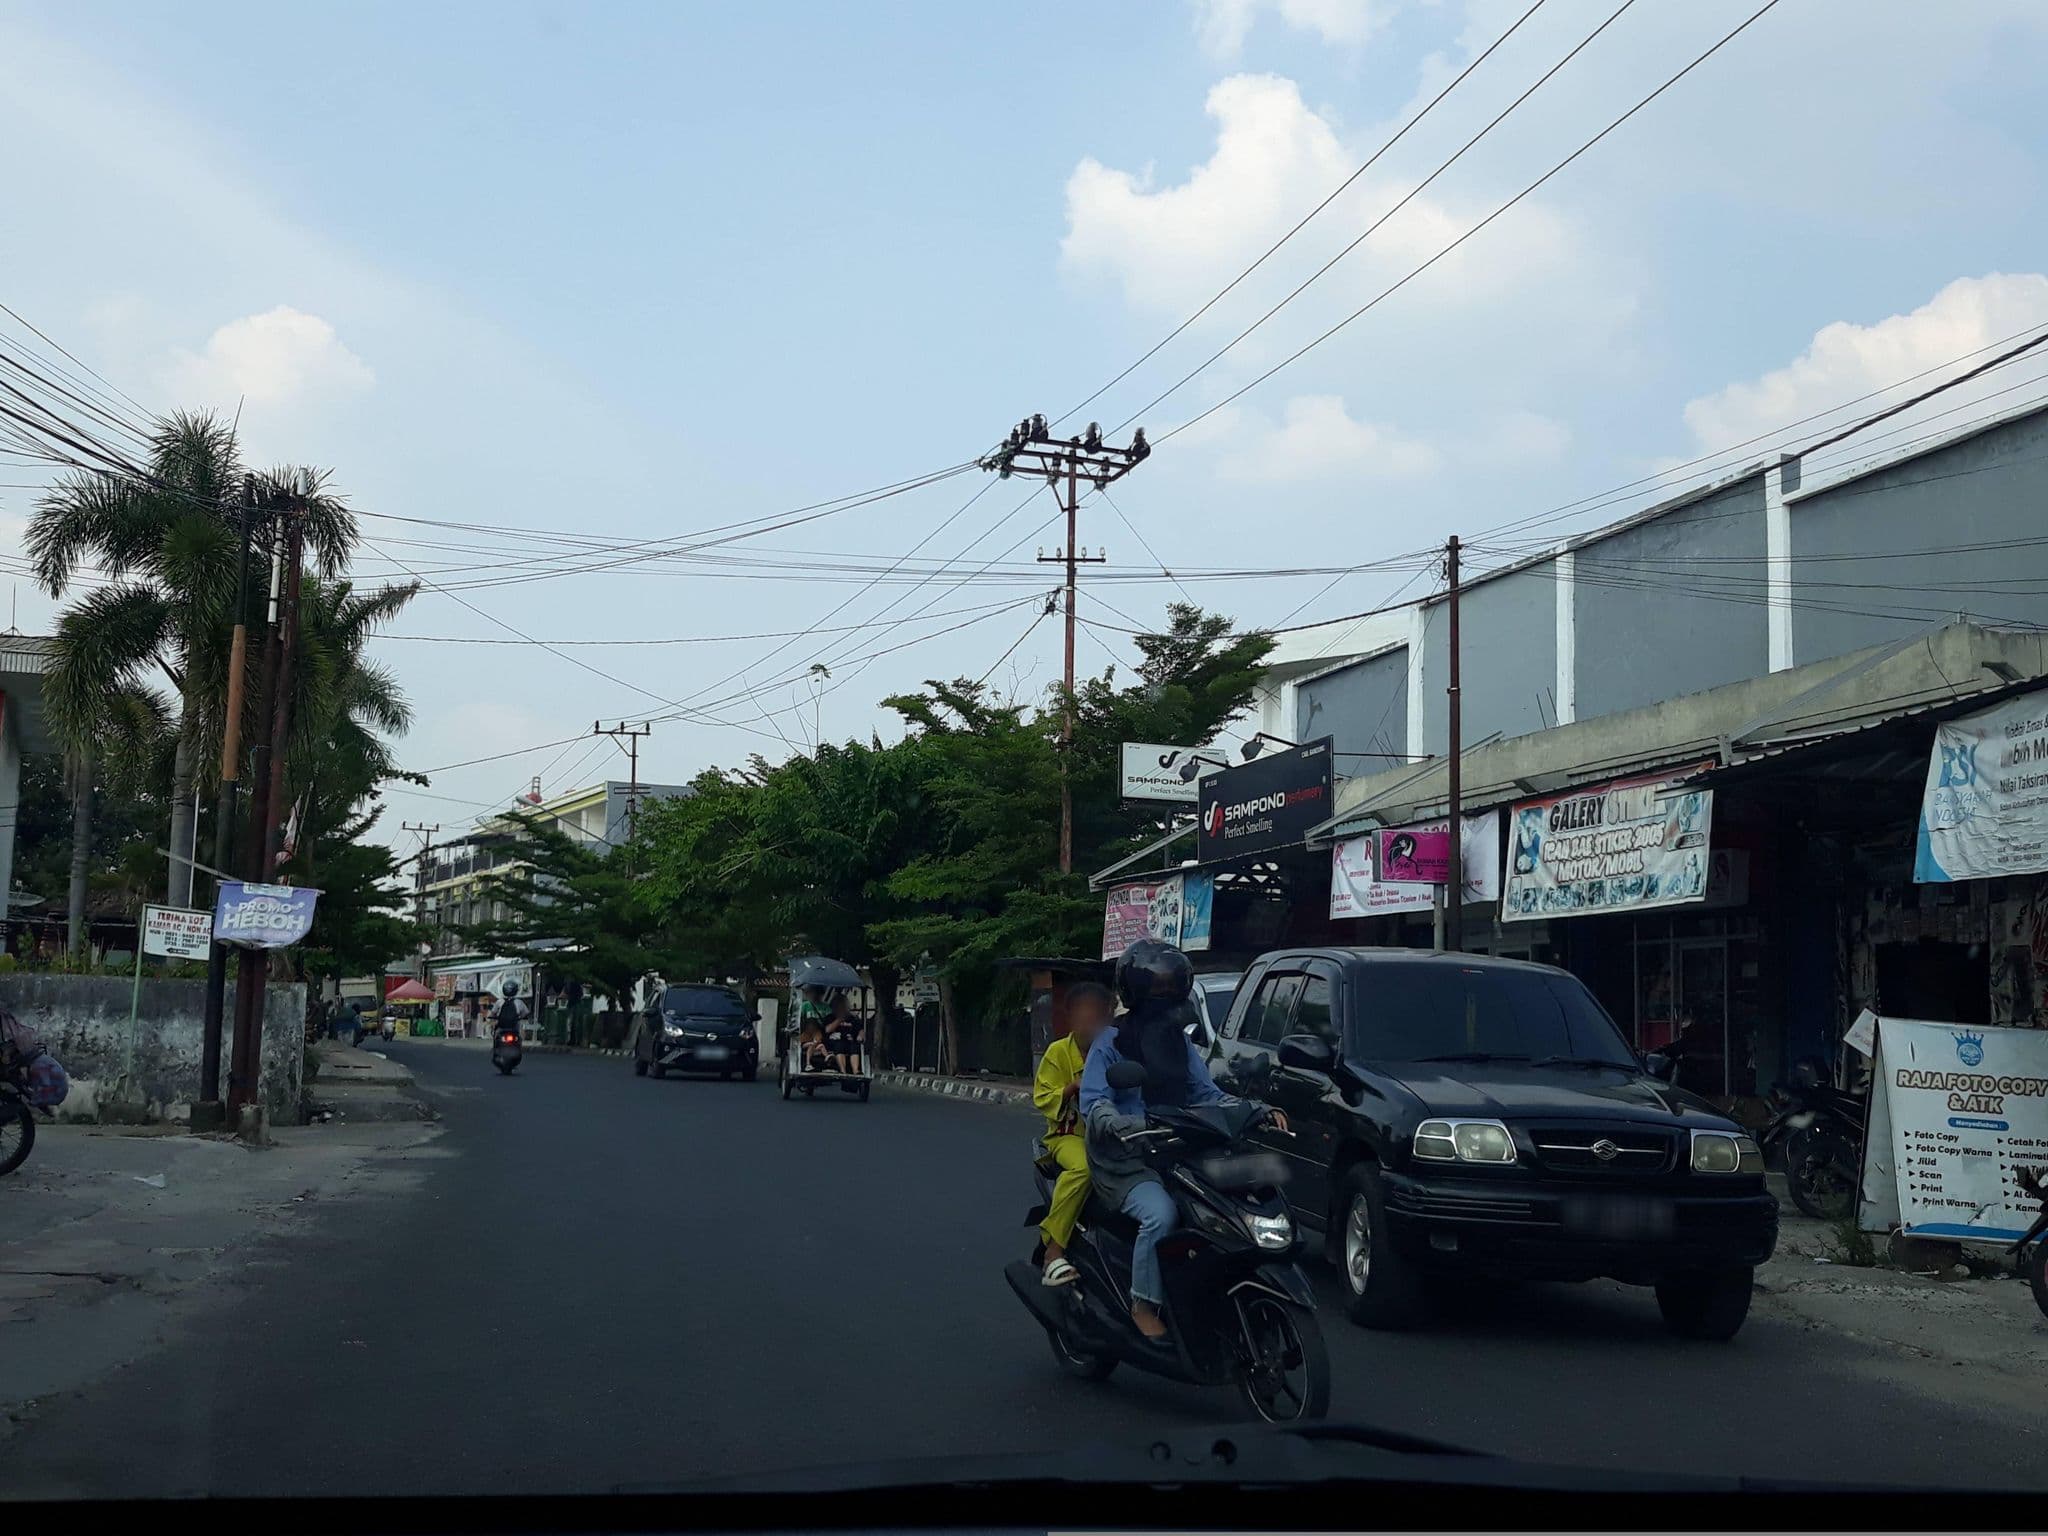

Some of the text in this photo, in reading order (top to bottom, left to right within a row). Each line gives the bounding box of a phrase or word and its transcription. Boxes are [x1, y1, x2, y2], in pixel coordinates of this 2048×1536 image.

[1224, 791, 1285, 821] SAMPONO
[1550, 796, 1606, 832] GALERY
[1224, 818, 1272, 839] Perfect Smelling
[238, 901, 292, 913] PROMO
[222, 912, 305, 930] HEBOH
[187, 925, 201, 933] NON
[1897, 1069, 2048, 1097] RAJA FOTO COPY
[1948, 1093, 2003, 1115] & ATK
[1914, 1131, 1959, 1143] Foto Copy
[2007, 1137, 2034, 1146] Cetak
[1916, 1144, 1993, 1157] Foto Copy Warna
[1917, 1157, 1937, 1166] Jilid
[1919, 1170, 1942, 1179] Scan
[1921, 1183, 1943, 1193] Print
[1922, 1197, 1976, 1208] Print Warna
